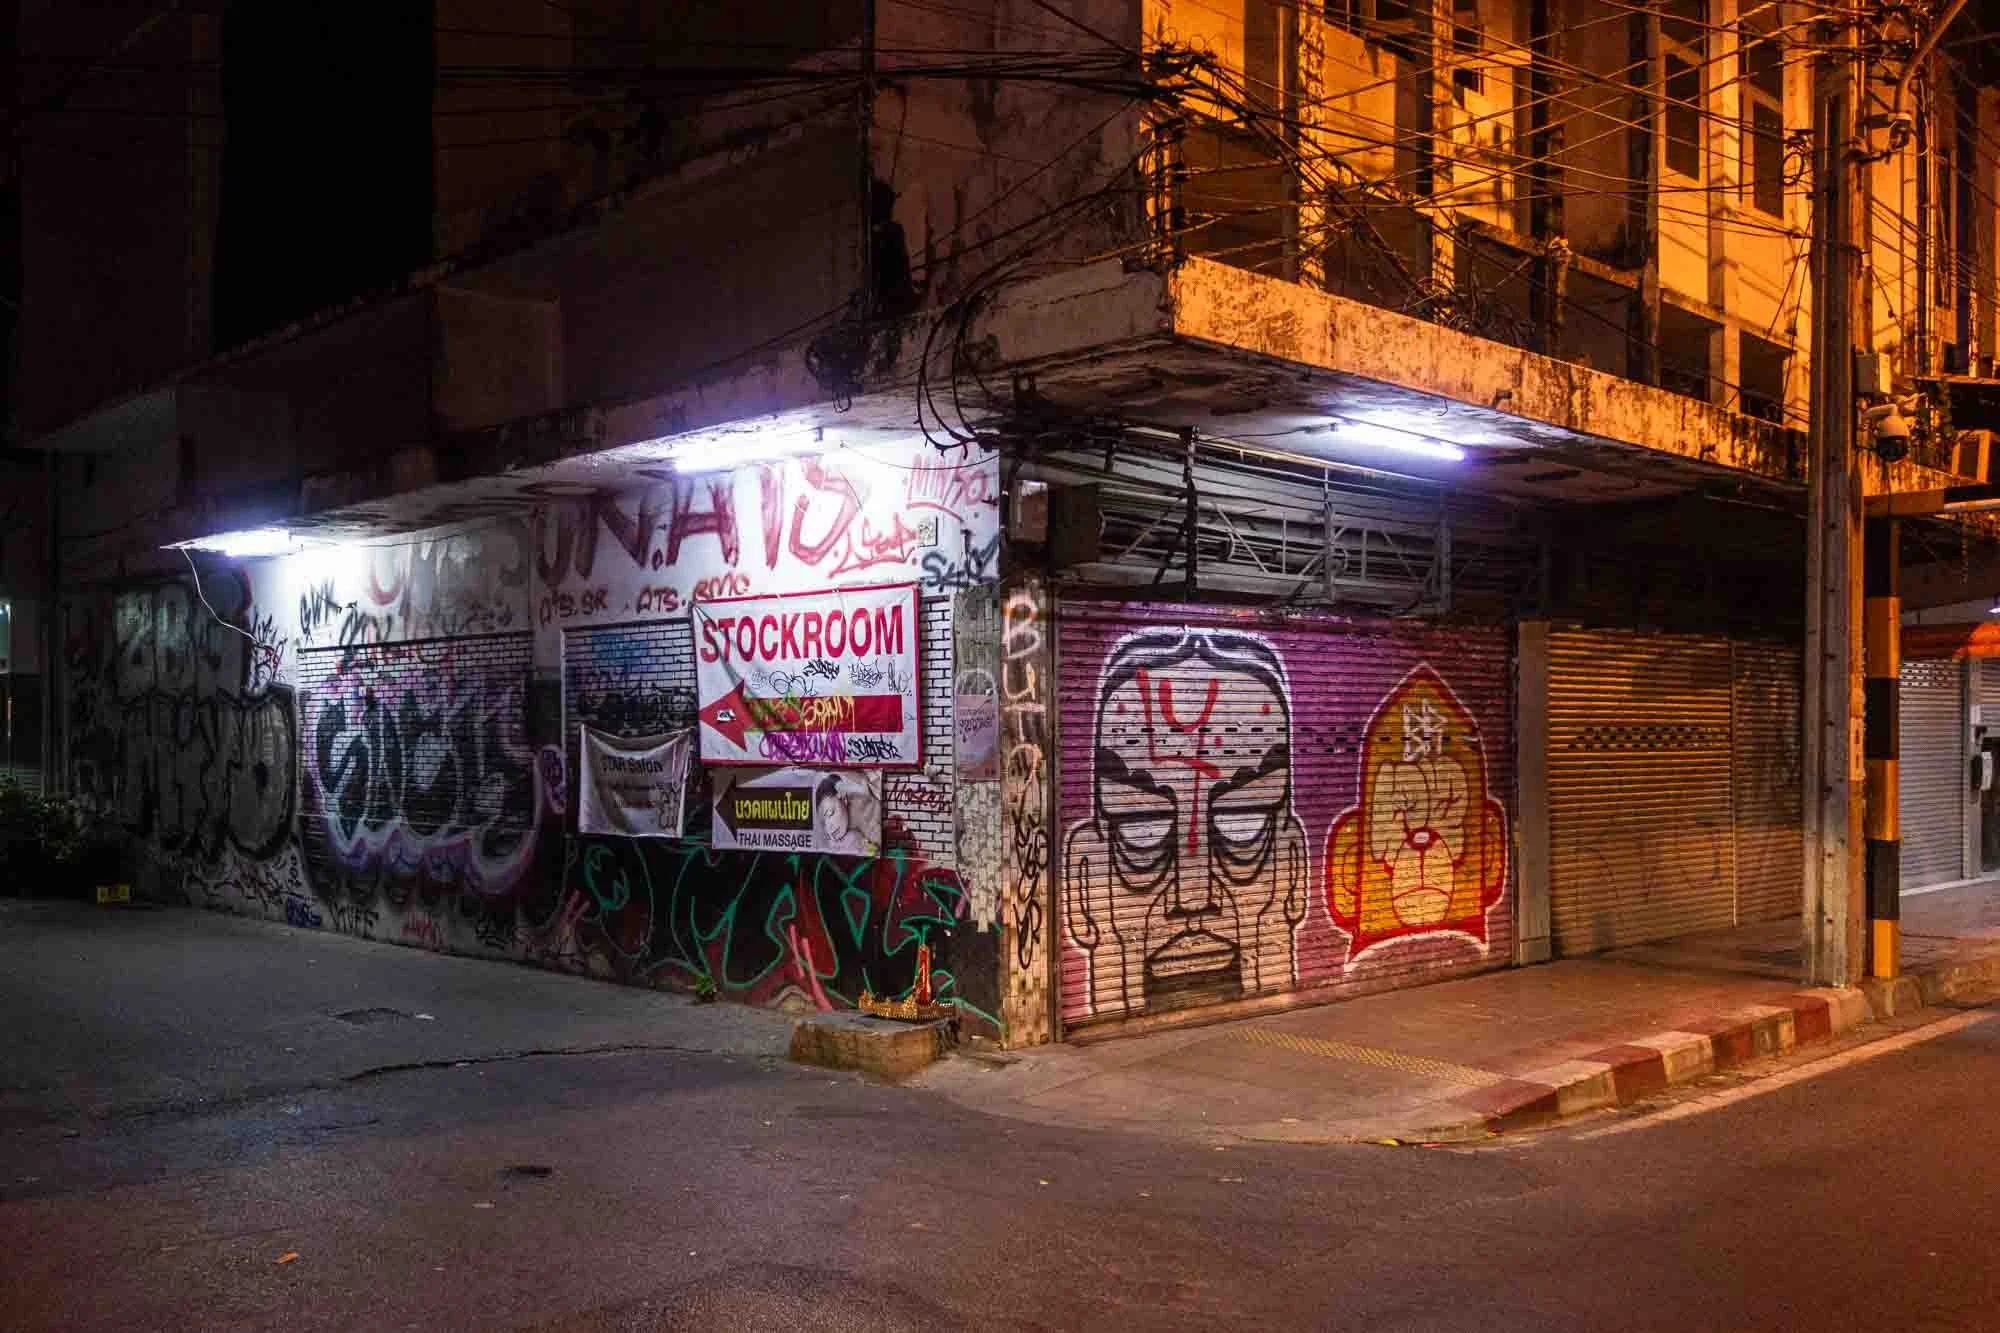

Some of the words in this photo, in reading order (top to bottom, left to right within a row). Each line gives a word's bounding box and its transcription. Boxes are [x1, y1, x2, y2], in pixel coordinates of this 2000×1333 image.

[700, 605, 904, 663] STOCKROOM
[735, 791, 810, 820] นวดแผนไทย
[739, 832, 761, 847] THAI
[763, 833, 812, 849] MASSAGE
